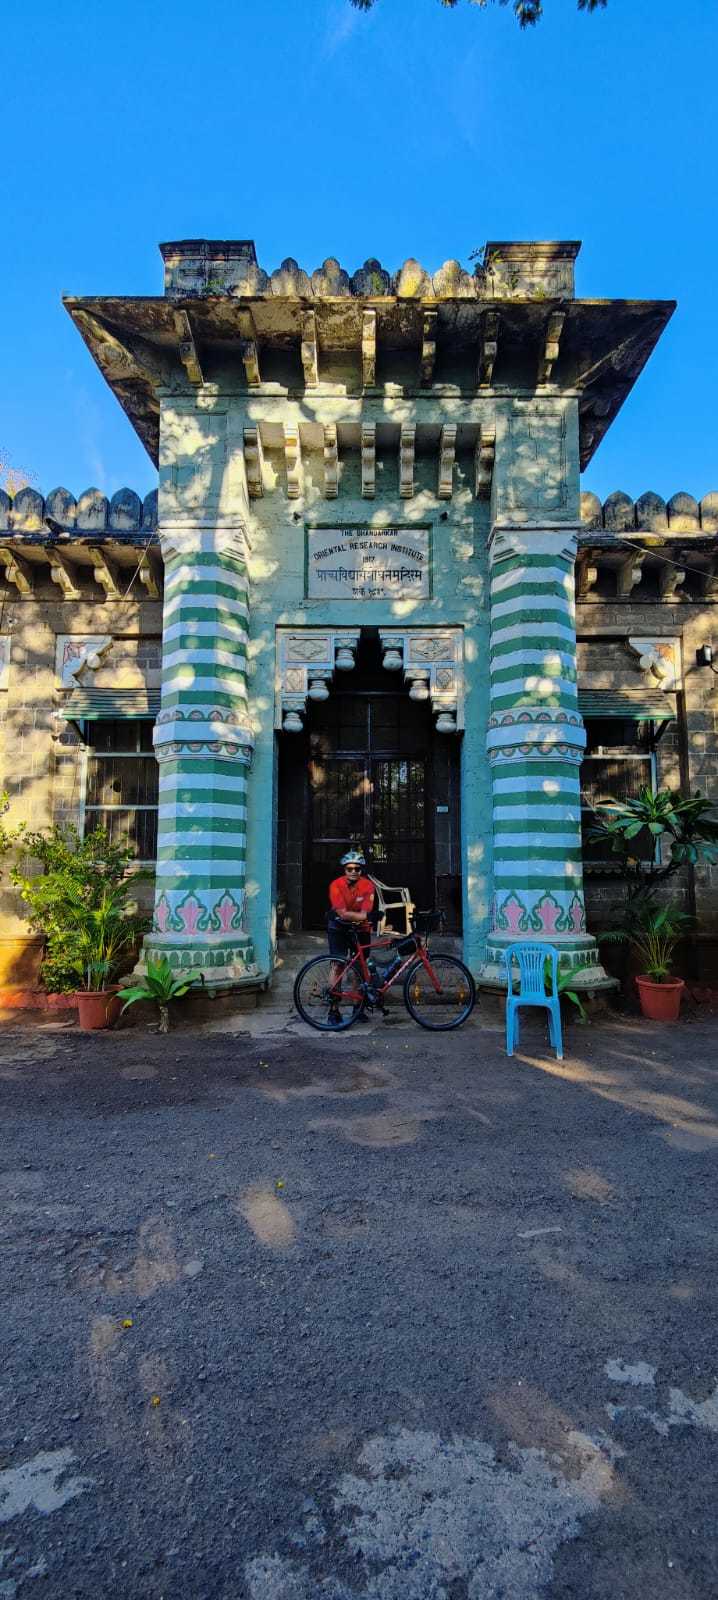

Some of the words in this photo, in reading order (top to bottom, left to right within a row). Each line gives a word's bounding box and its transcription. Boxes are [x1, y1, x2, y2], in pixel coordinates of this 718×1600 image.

[341, 529, 353, 537] THE
[356, 529, 398, 537] BHANDARKAR
[313, 545, 347, 561] ORIENTAL
[349, 541, 388, 551] RESEARCH
[390, 544, 425, 561] INSTITUTE
[362, 555, 376, 563] 1917
